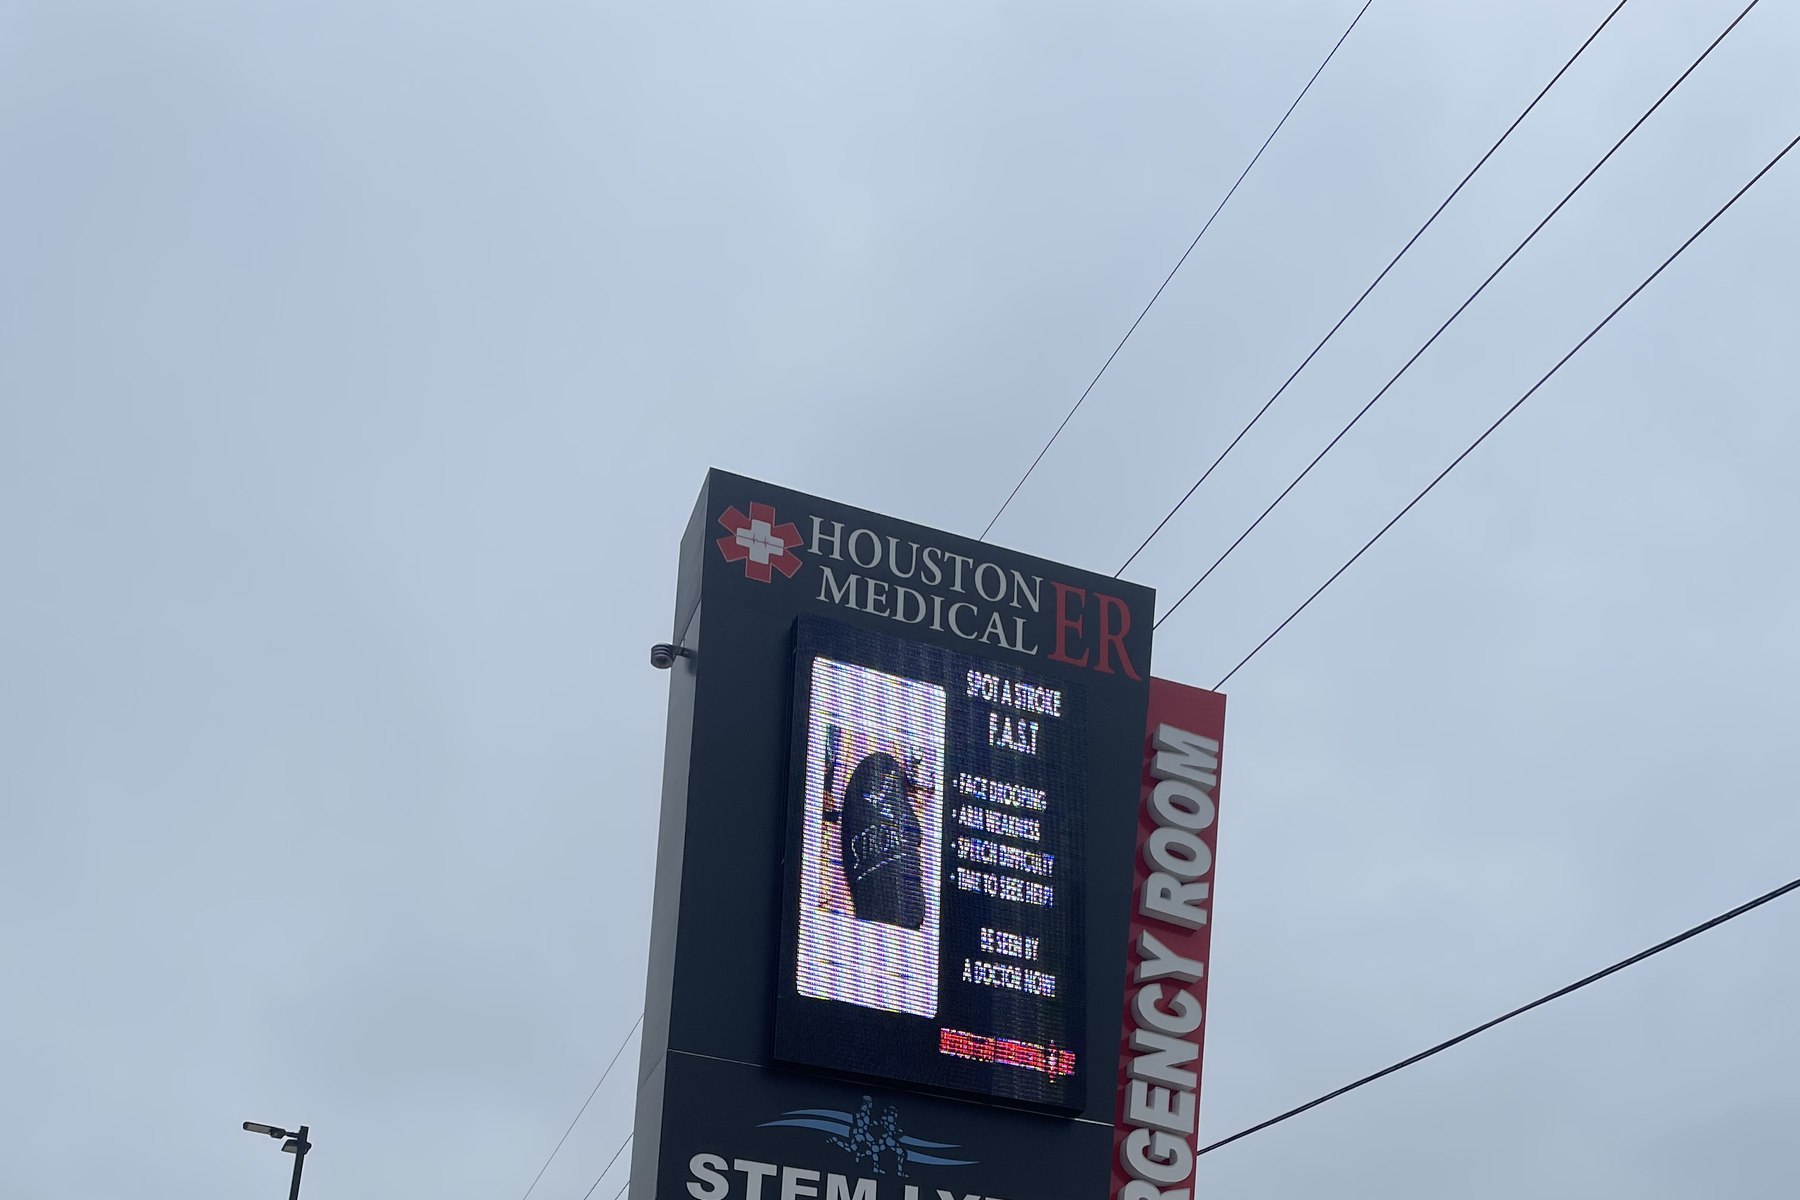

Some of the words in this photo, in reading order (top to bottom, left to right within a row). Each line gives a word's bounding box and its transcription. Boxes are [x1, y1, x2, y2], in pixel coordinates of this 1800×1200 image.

[807, 515, 1044, 612] HOUSTON
[816, 566, 1039, 656] MEDICAL
[1048, 581, 1142, 682] ER
[967, 669, 999, 702] SPOT
[1001, 680, 1012, 706] A
[1014, 682, 1062, 717] STROKE
[1138, 722, 1219, 931] ROOM
[962, 958, 972, 982] A
